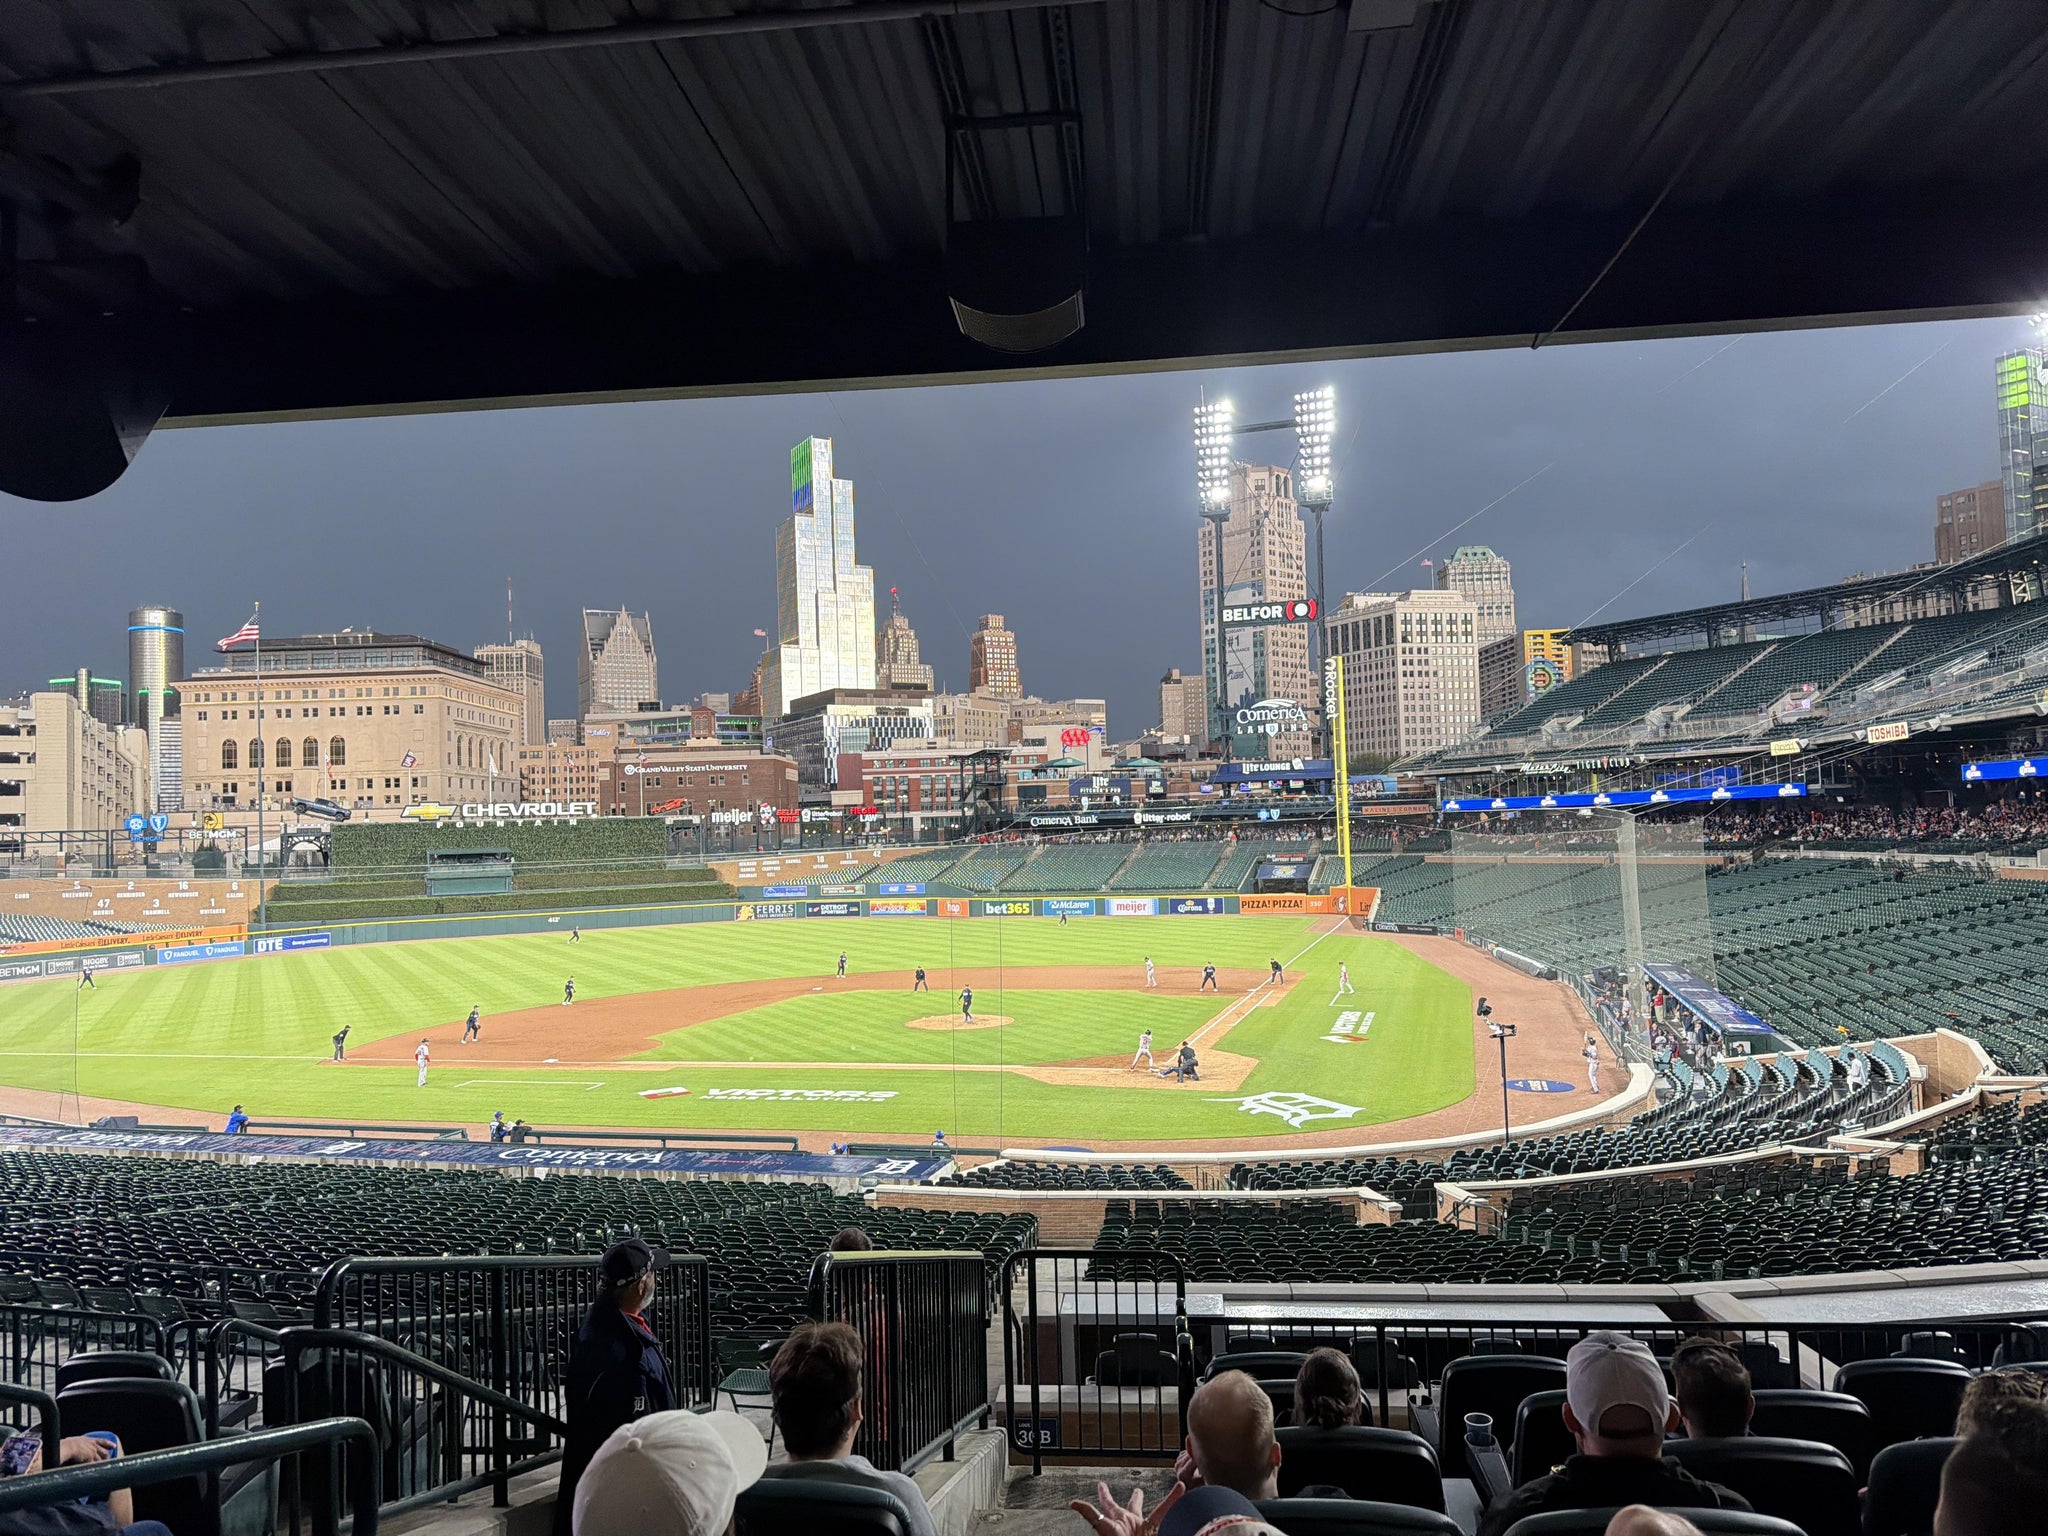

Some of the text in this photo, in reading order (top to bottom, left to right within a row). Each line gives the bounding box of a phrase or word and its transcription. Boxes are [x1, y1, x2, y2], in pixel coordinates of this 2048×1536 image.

[1222, 607, 1283, 623] BELFOR
[1325, 670, 1339, 719] Rocket
[1237, 723, 1308, 737] LANDING
[1869, 725, 1907, 741] TOSHIBA
[660, 765, 684, 773] VALLEY
[685, 764, 706, 773] STATE
[705, 763, 748, 772] UNIVERSITY
[1260, 763, 1291, 772] LOUNGE
[1576, 759, 1602, 770] TIGER
[462, 801, 597, 817] CHEVROLET
[711, 808, 754, 825] meijer
[779, 815, 798, 823] TIRE
[859, 813, 877, 822] LAW
[1074, 814, 1099, 824] Bank
[436, 818, 577, 829] FOUNTAIN
[189, 831, 236, 840] BETMGM
[873, 850, 881, 858] 42
[74, 881, 81, 889] 5
[127, 881, 135, 890] 2
[178, 881, 189, 890] 16
[231, 882, 239, 891] 6
[97, 899, 111, 908] 47
[152, 899, 160, 908] 3
[210, 899, 216, 907] 1
[1059, 901, 1090, 909] McLaren
[1116, 902, 1148, 913] meijer
[1241, 899, 1303, 909] PIZZA! PIZZA!
[756, 905, 794, 914] FERRIS
[986, 903, 1030, 914] bet365
[1177, 904, 1203, 913] Corona
[257, 938, 283, 953] DTE
[173, 950, 200, 958] FANDUEL
[82, 957, 110, 967] BIGGBY
[0, 965, 40, 977] BETMGM
[709, 1088, 899, 1099] VICTORS
